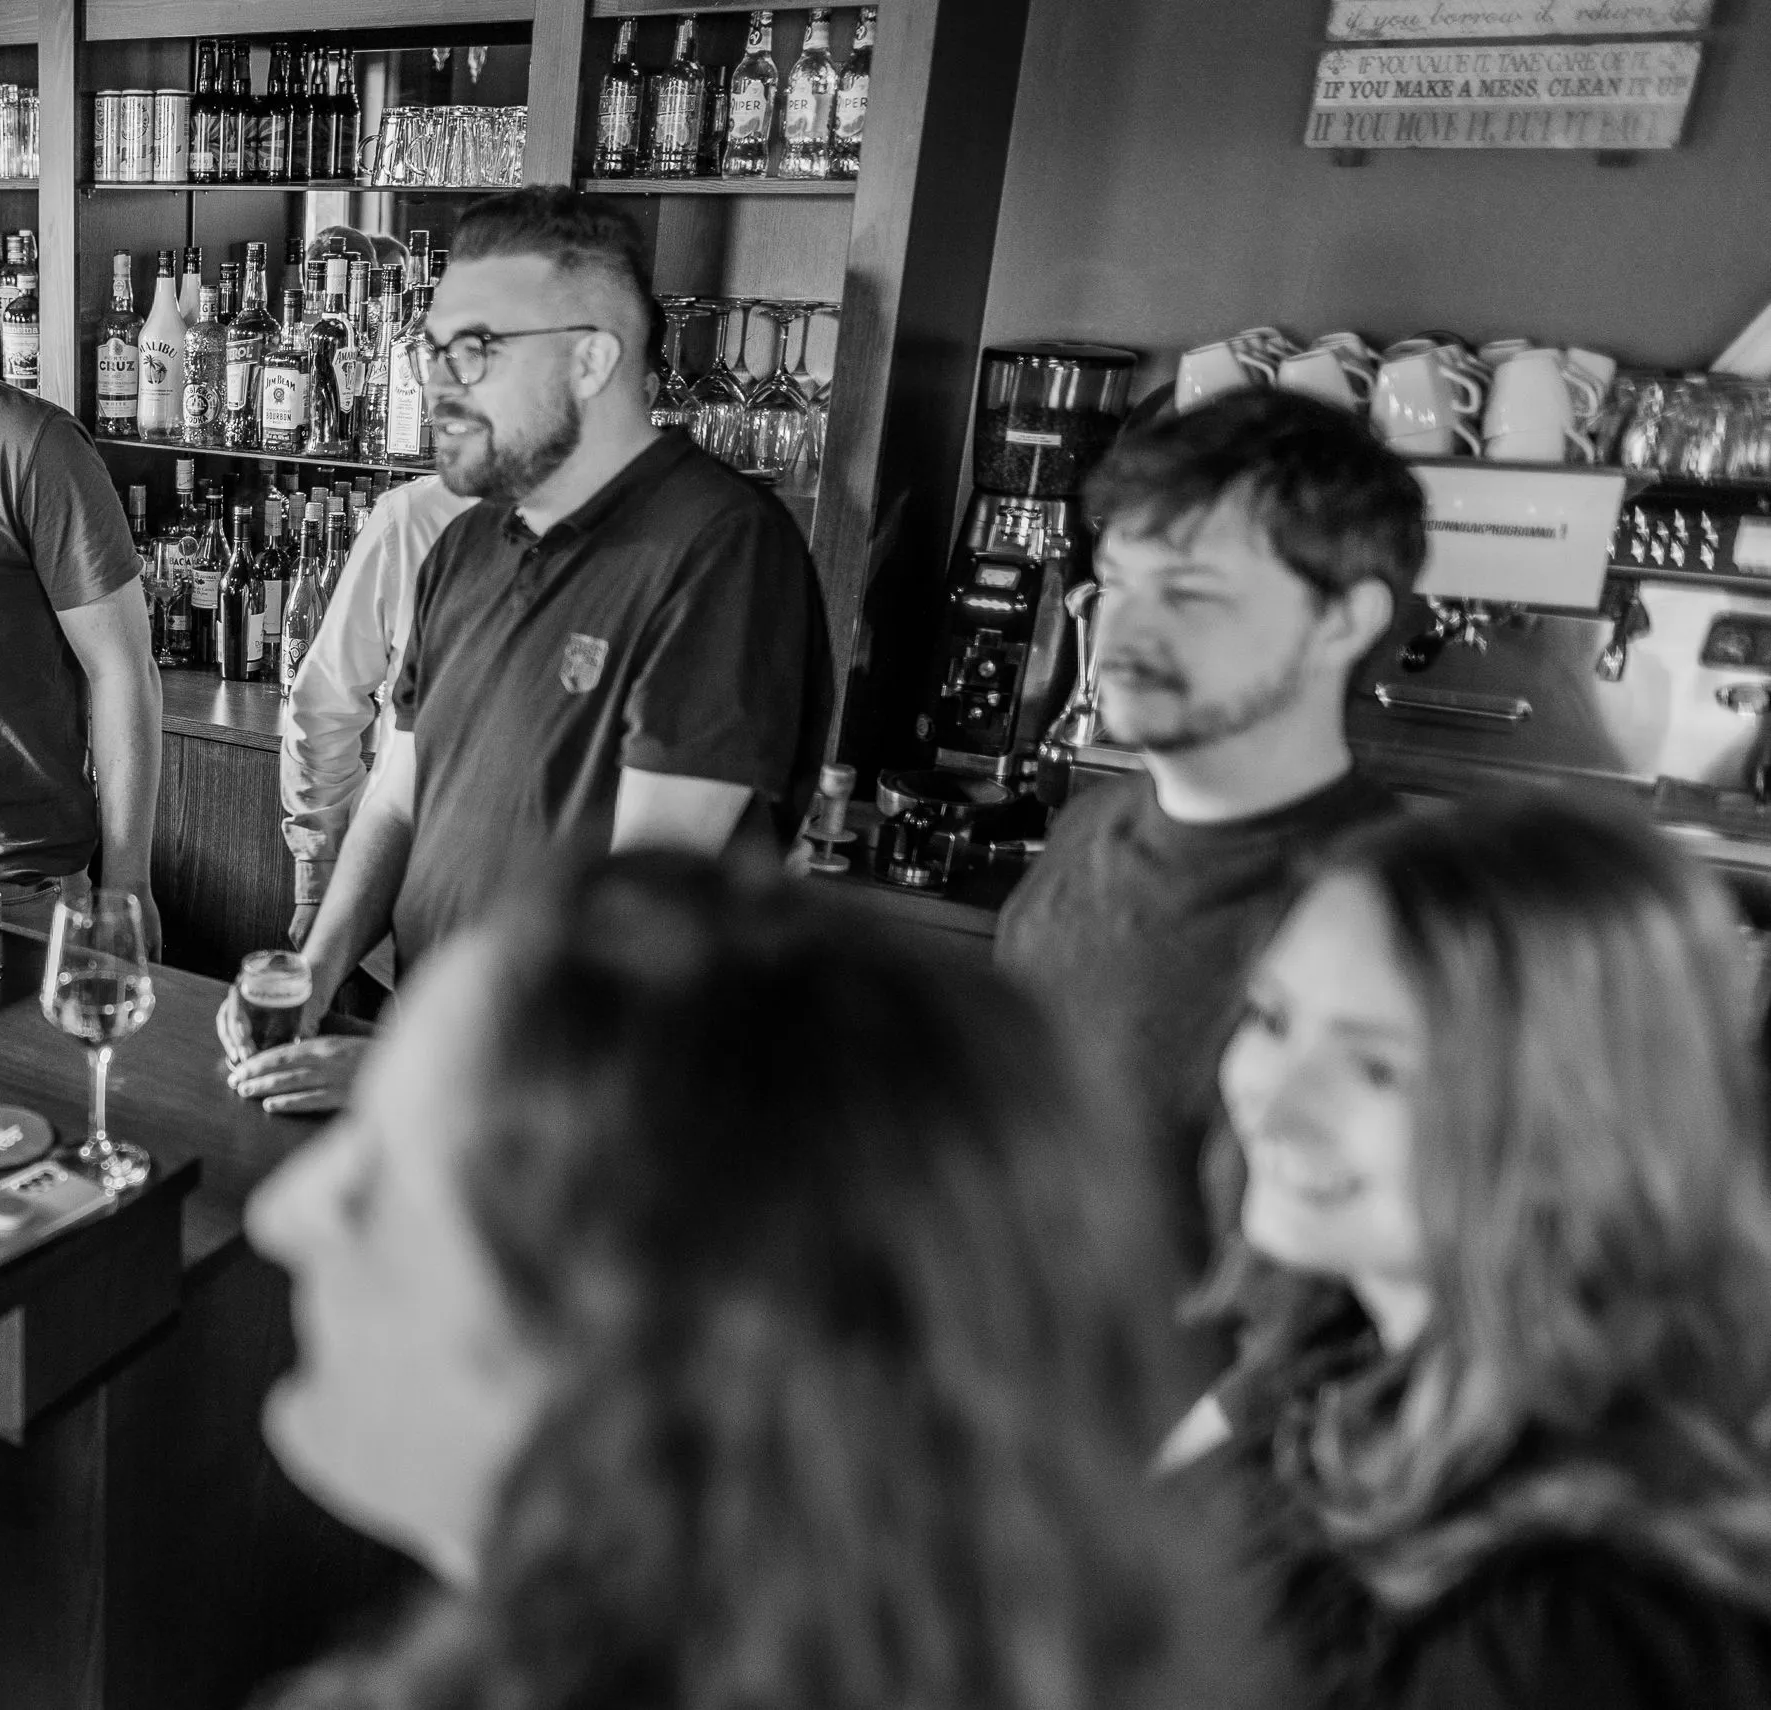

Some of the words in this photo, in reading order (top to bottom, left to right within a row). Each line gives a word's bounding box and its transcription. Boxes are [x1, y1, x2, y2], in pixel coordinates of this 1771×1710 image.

[1358, 55, 1376, 74] IF
[1378, 54, 1415, 74] YOU
[1323, 80, 1345, 99] IF
[1347, 80, 1391, 99] YOU
[1391, 79, 1455, 98] MAKE
[1456, 79, 1472, 98] A
[1547, 77, 1623, 97] CLEAN
[1313, 112, 1338, 142] IF
[1342, 112, 1391, 142] YOU
[1394, 111, 1460, 142] MOVE
[99, 360, 135, 372] CRUZ
